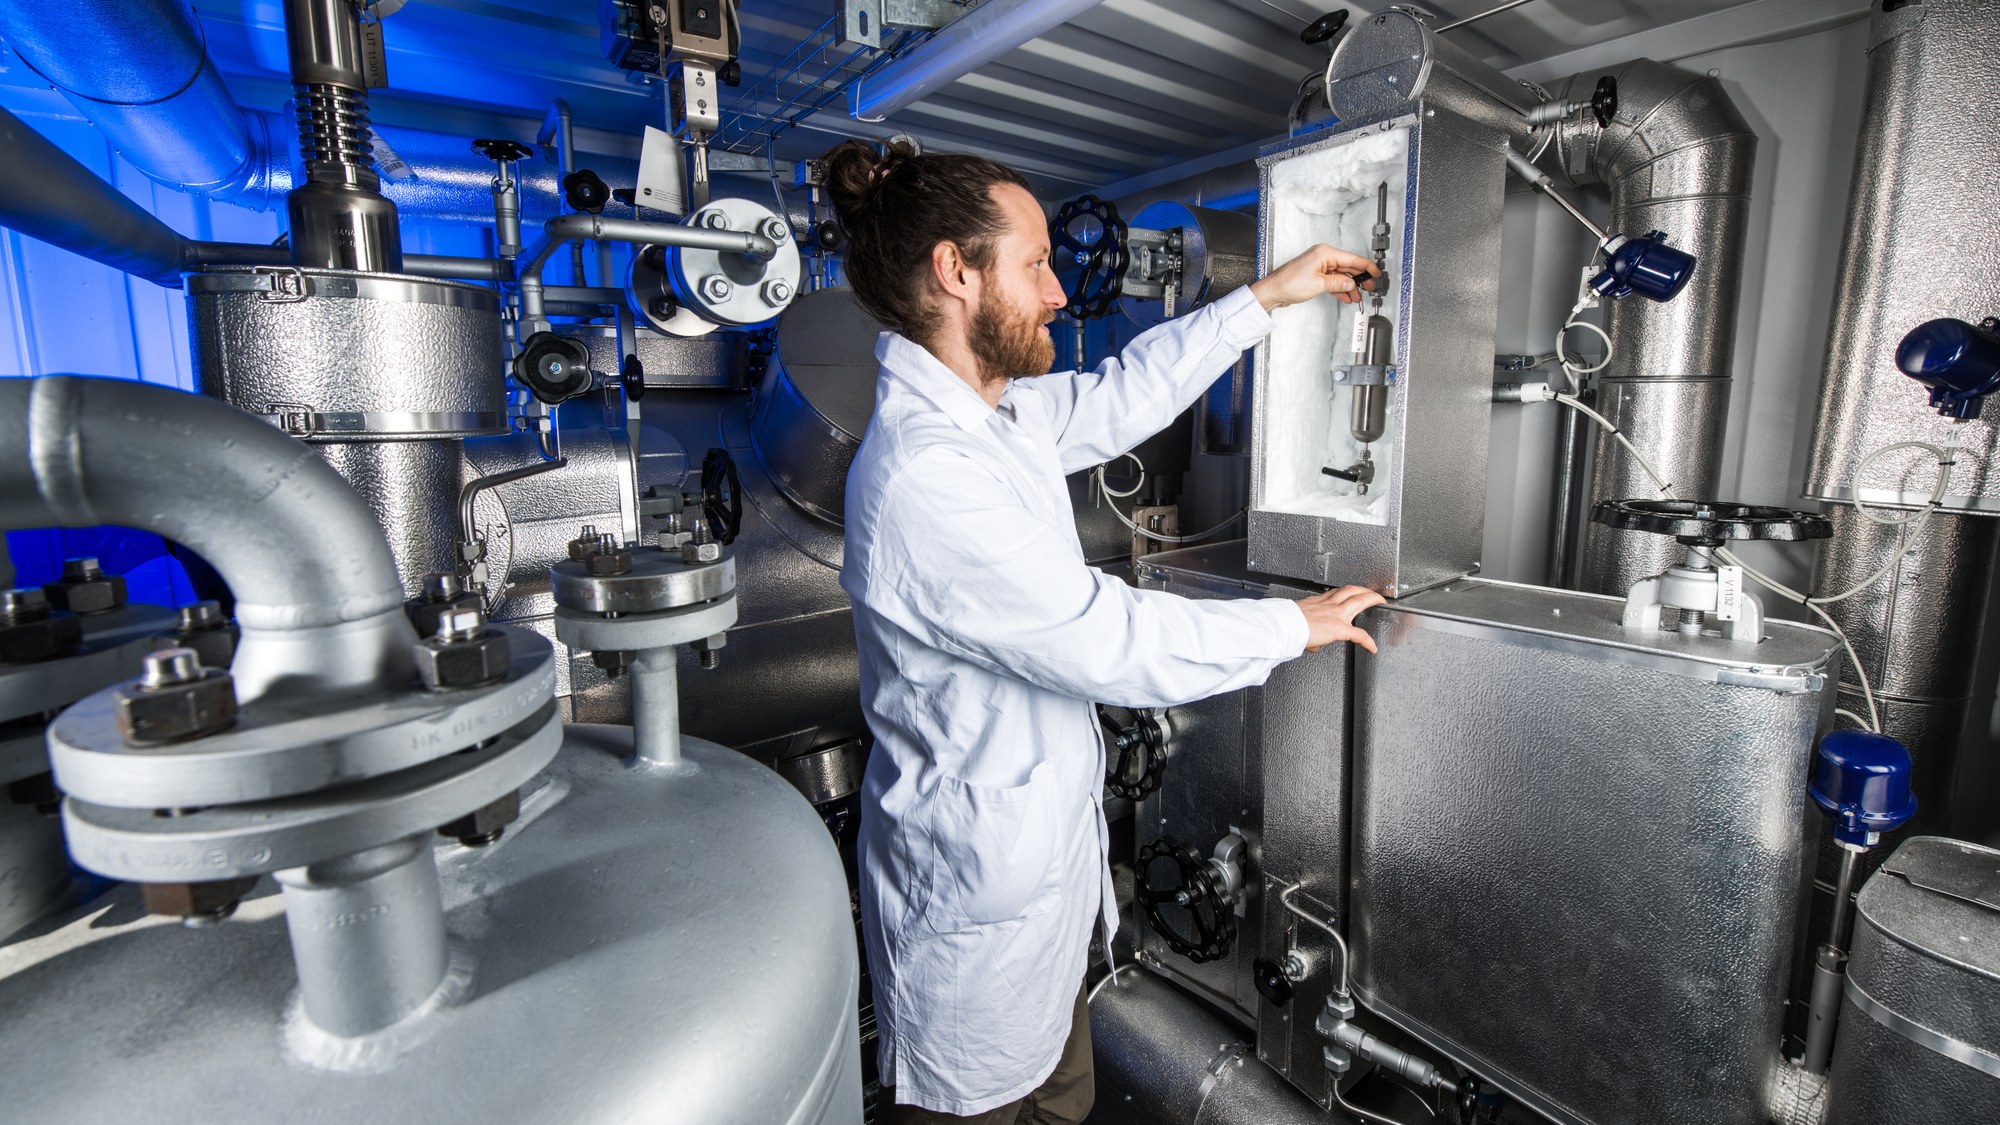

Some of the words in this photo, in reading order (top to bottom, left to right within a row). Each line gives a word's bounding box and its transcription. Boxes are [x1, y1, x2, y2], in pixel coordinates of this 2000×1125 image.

[366, 32, 376, 48] LIT
[368, 51, 378, 77] 11301
[1724, 589, 1734, 607] 1132
